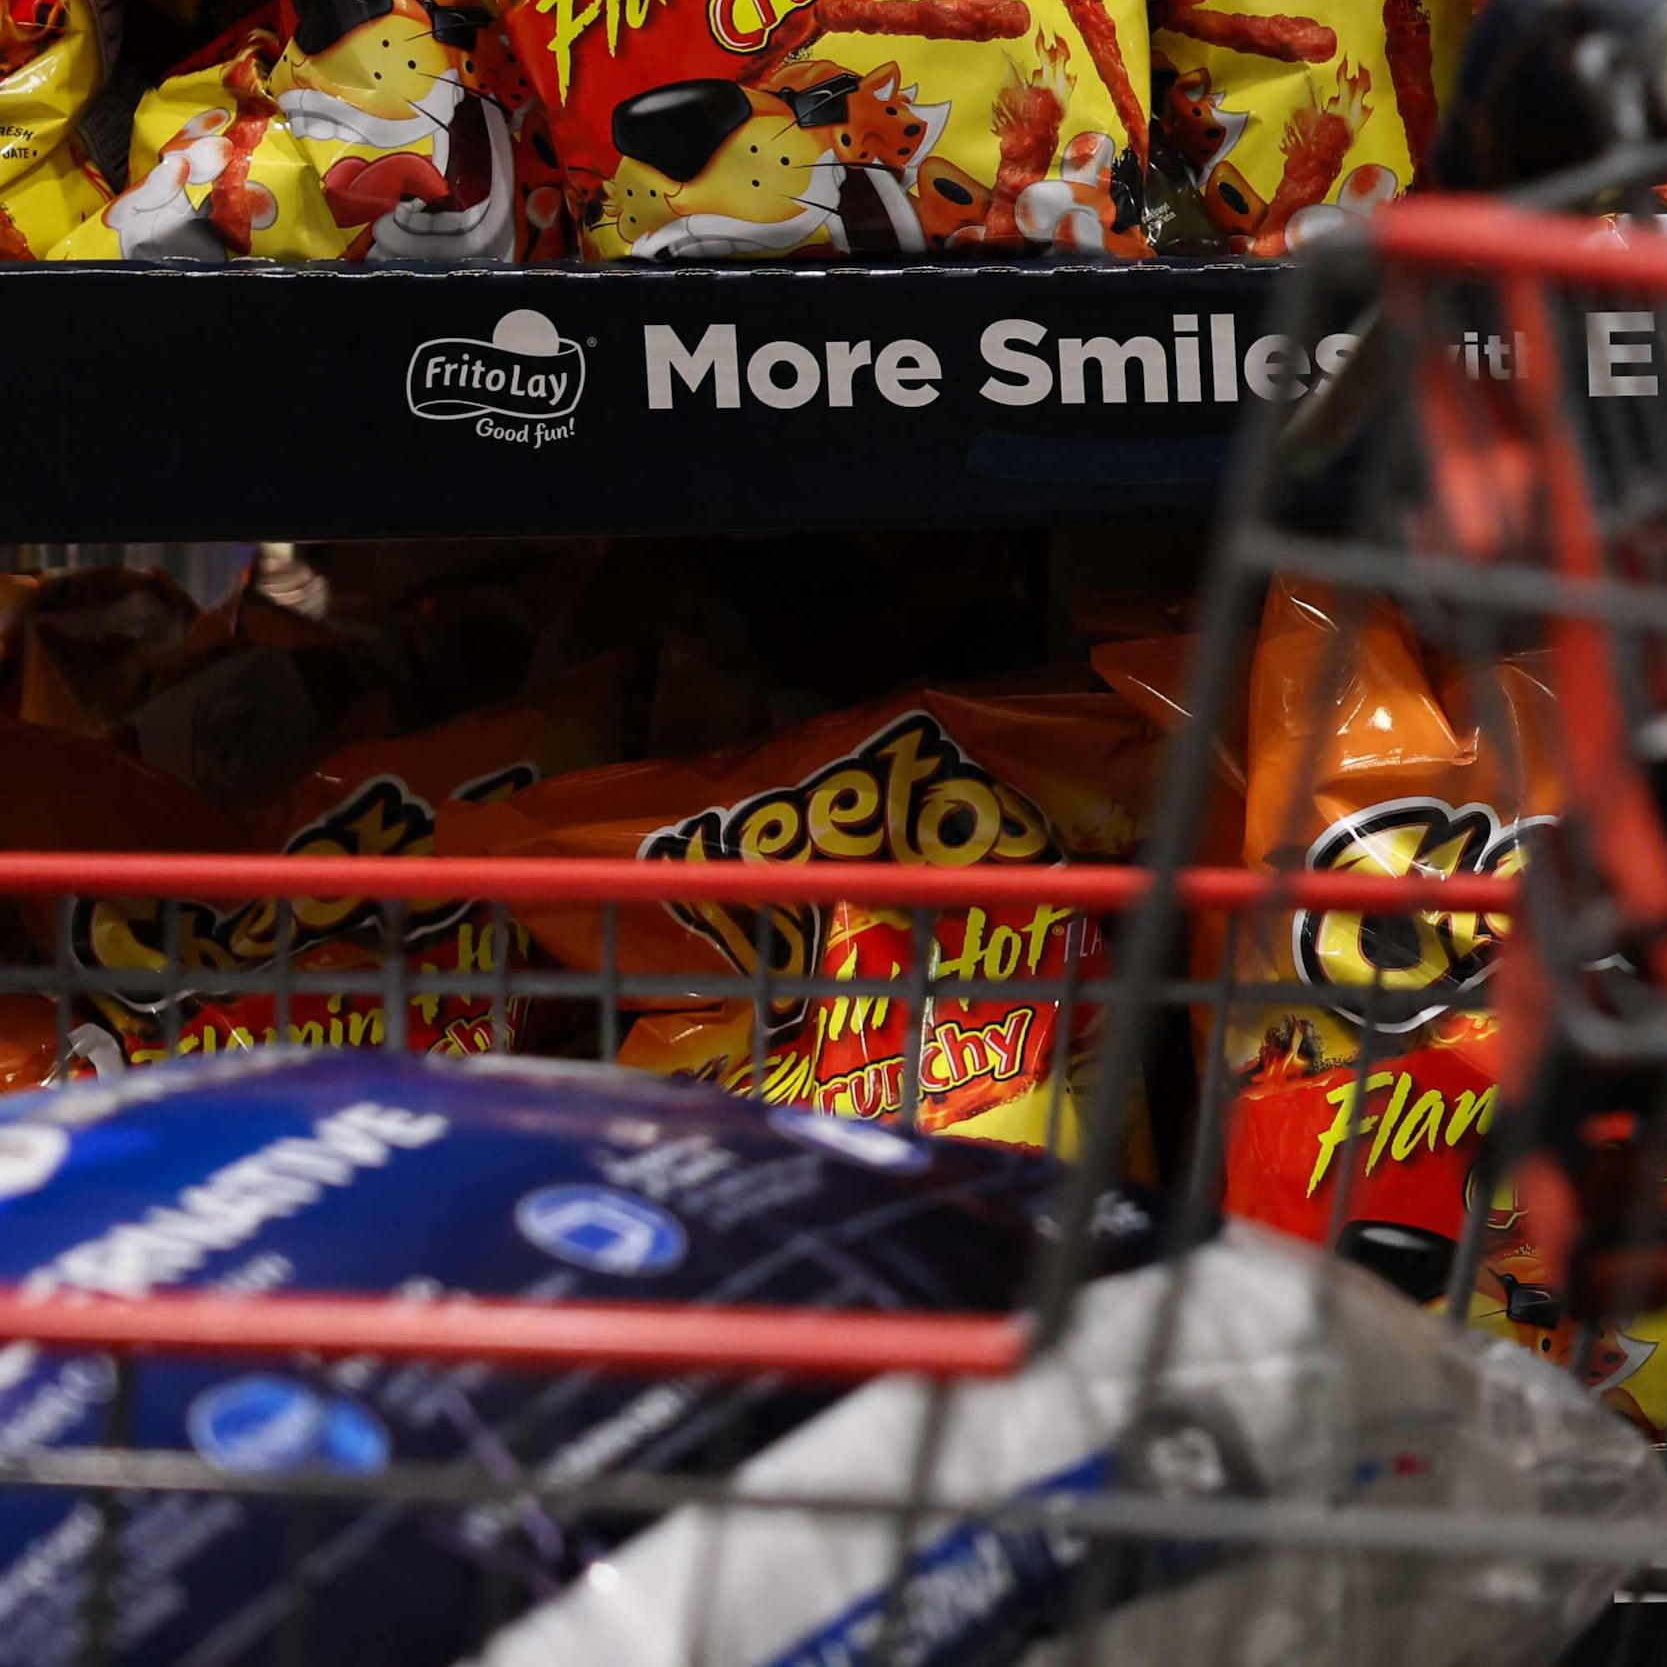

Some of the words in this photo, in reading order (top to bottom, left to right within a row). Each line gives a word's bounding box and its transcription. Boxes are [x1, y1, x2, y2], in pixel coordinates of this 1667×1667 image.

[643, 323, 943, 411] More
[475, 417, 529, 445] Good
[532, 419, 576, 449] fun!
